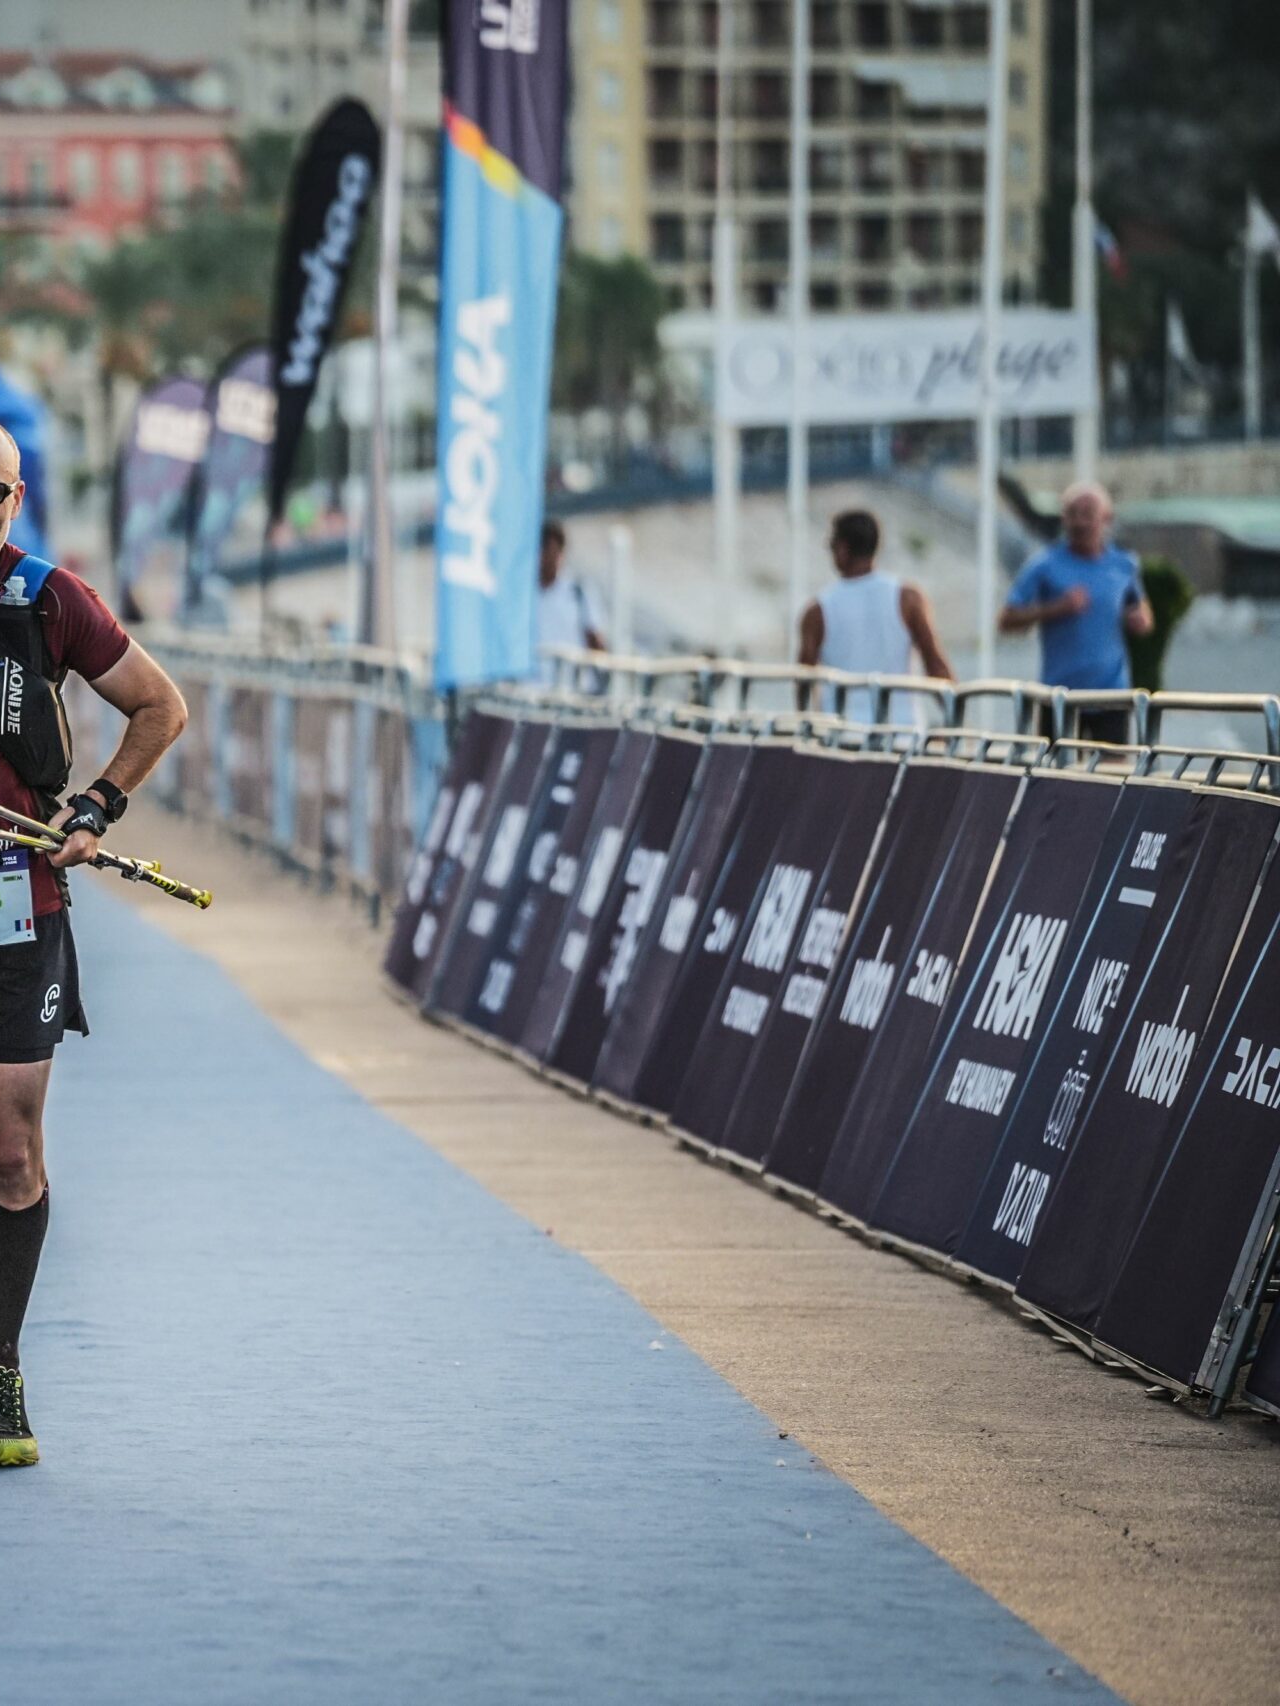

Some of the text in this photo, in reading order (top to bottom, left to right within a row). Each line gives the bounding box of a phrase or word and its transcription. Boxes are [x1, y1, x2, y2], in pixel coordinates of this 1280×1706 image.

[279, 152, 373, 386] wahoo
[442, 293, 513, 597] HOKA
[7, 660, 23, 735] AONIJIE
[972, 912, 1068, 1041] HOKA
[1072, 954, 1123, 1035] NICE
[1124, 984, 1197, 1108] wahoo
[993, 1162, 1051, 1247] D'AZUR
